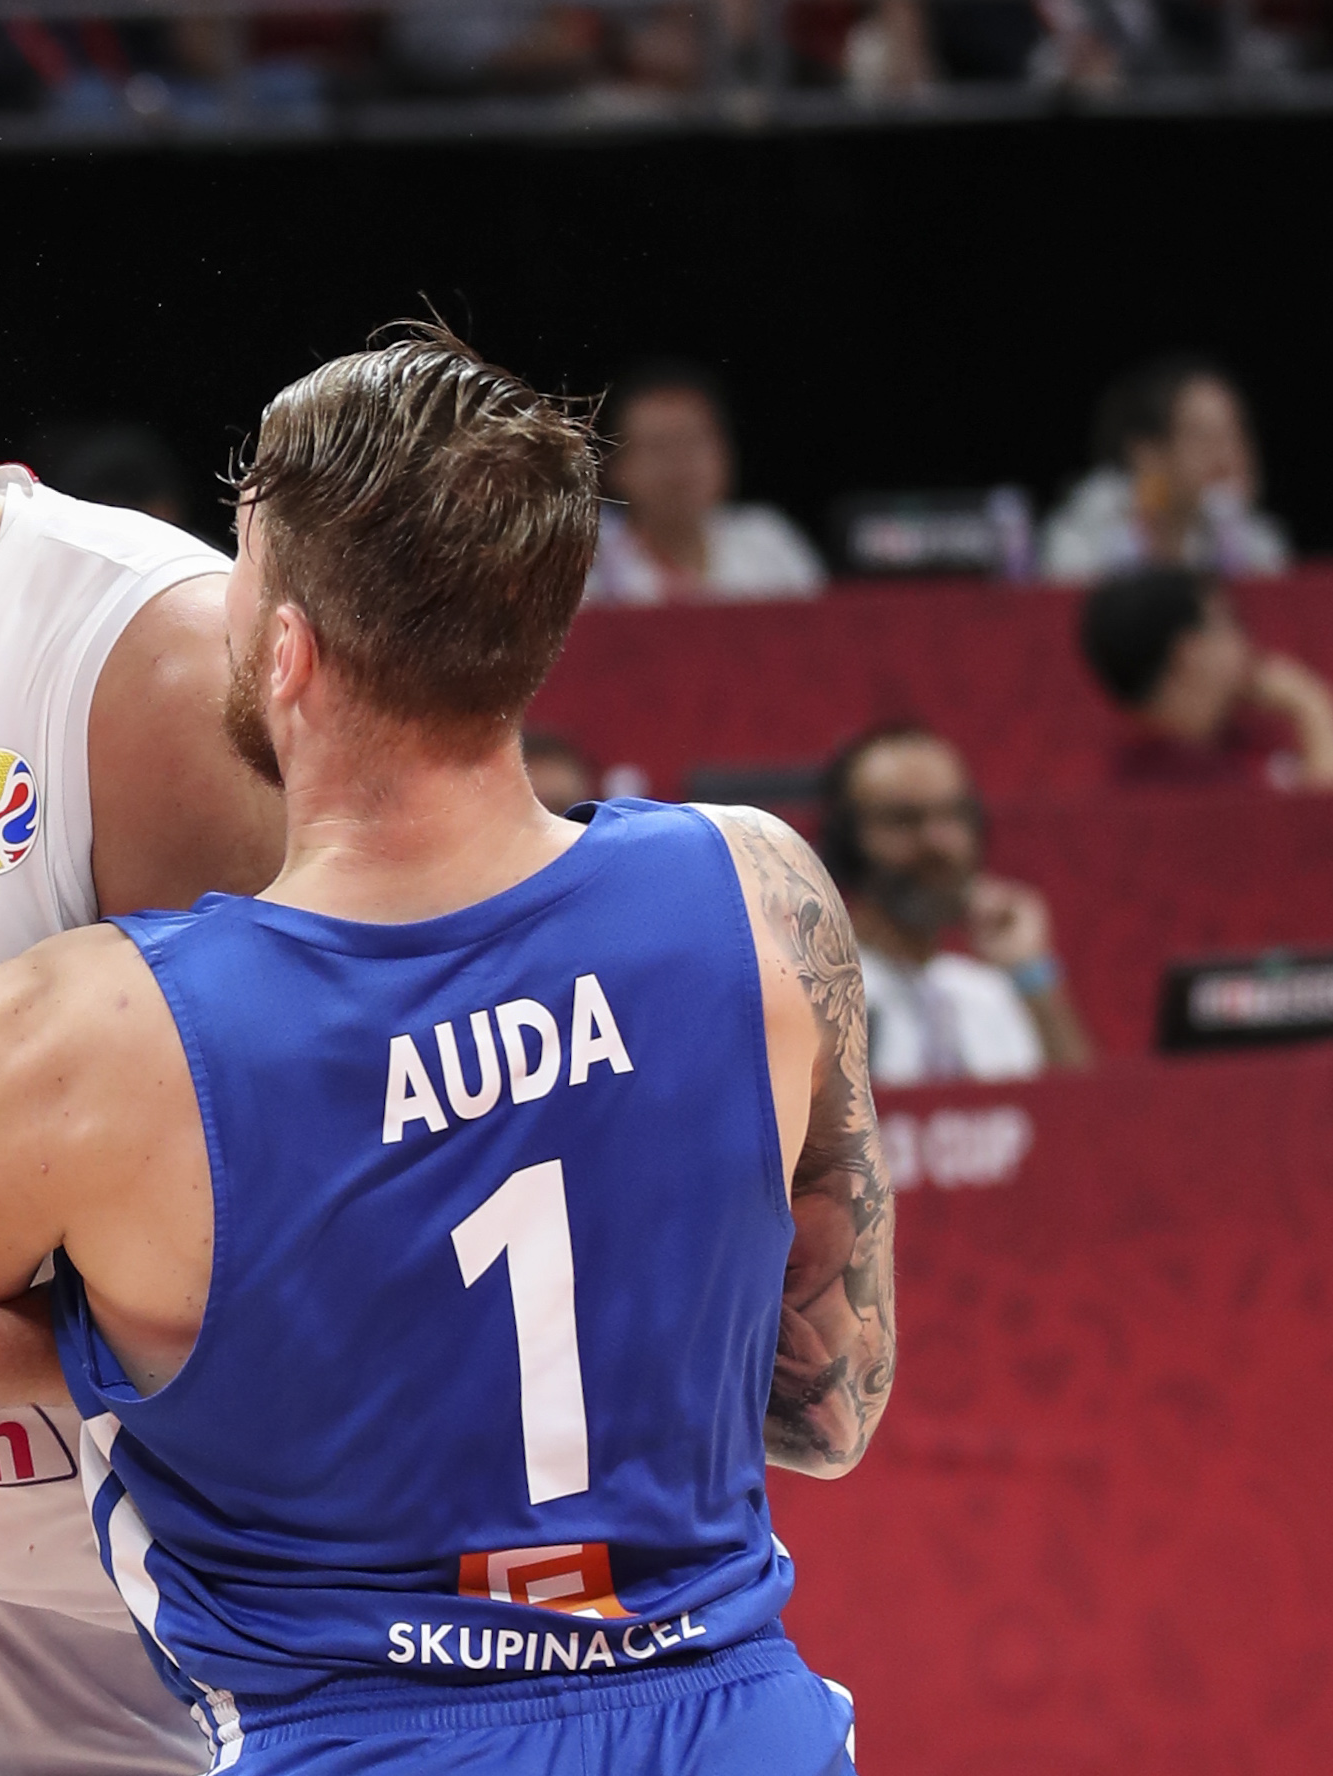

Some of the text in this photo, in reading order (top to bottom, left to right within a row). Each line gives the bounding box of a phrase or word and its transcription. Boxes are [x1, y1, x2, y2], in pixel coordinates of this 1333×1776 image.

[381, 973, 634, 1145] AUDA
[450, 1158, 590, 1506] 1
[386, 1621, 617, 1672] SKUPINA
